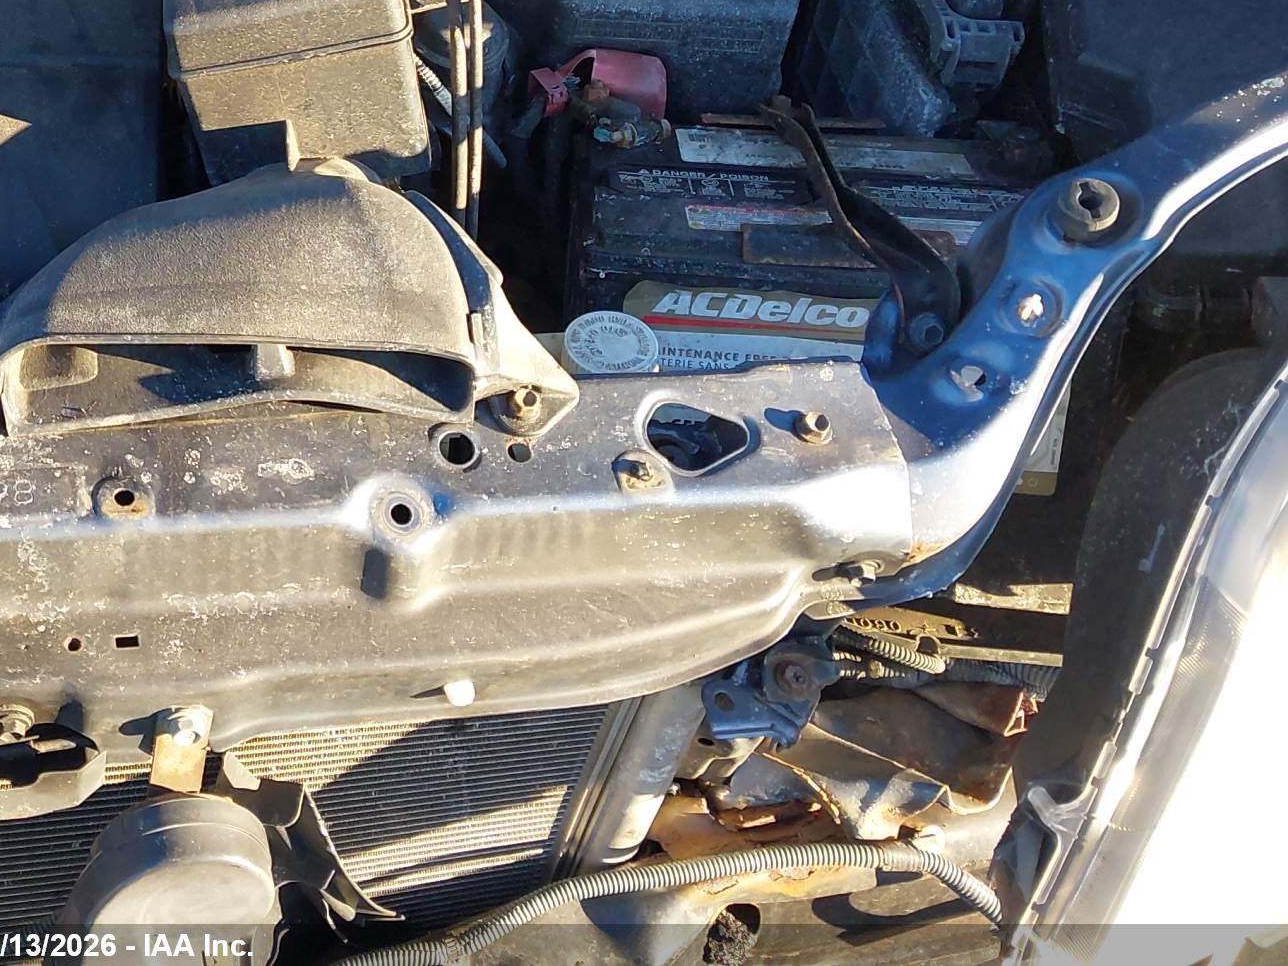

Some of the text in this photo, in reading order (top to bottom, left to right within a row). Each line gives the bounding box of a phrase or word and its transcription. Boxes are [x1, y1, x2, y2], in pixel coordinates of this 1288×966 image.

[652, 289, 870, 327] ACDelco
[661, 346, 740, 362] INTENANCE
[661, 358, 693, 370] TERIE
